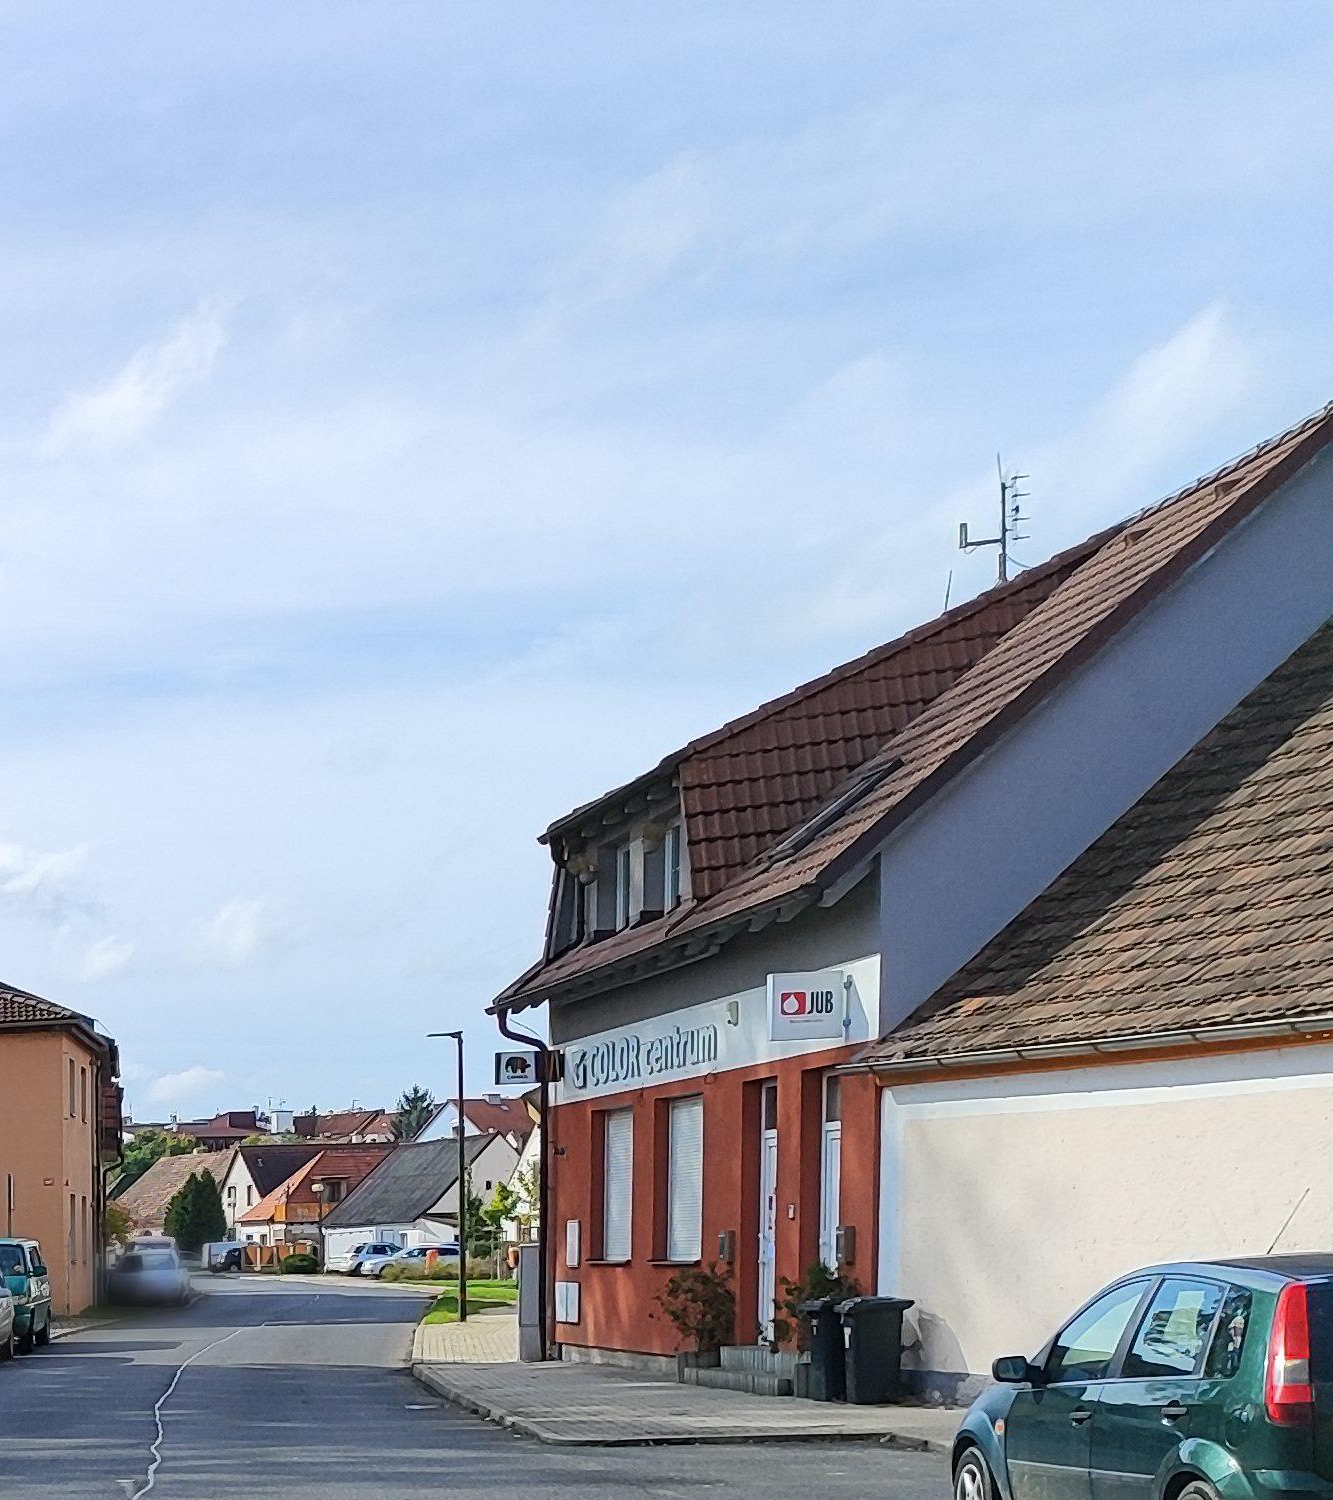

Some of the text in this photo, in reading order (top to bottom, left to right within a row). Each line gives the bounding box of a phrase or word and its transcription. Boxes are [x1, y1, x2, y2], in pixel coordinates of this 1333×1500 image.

[807, 990, 834, 1014] JUB
[591, 1024, 718, 1087] COLOR centrum
